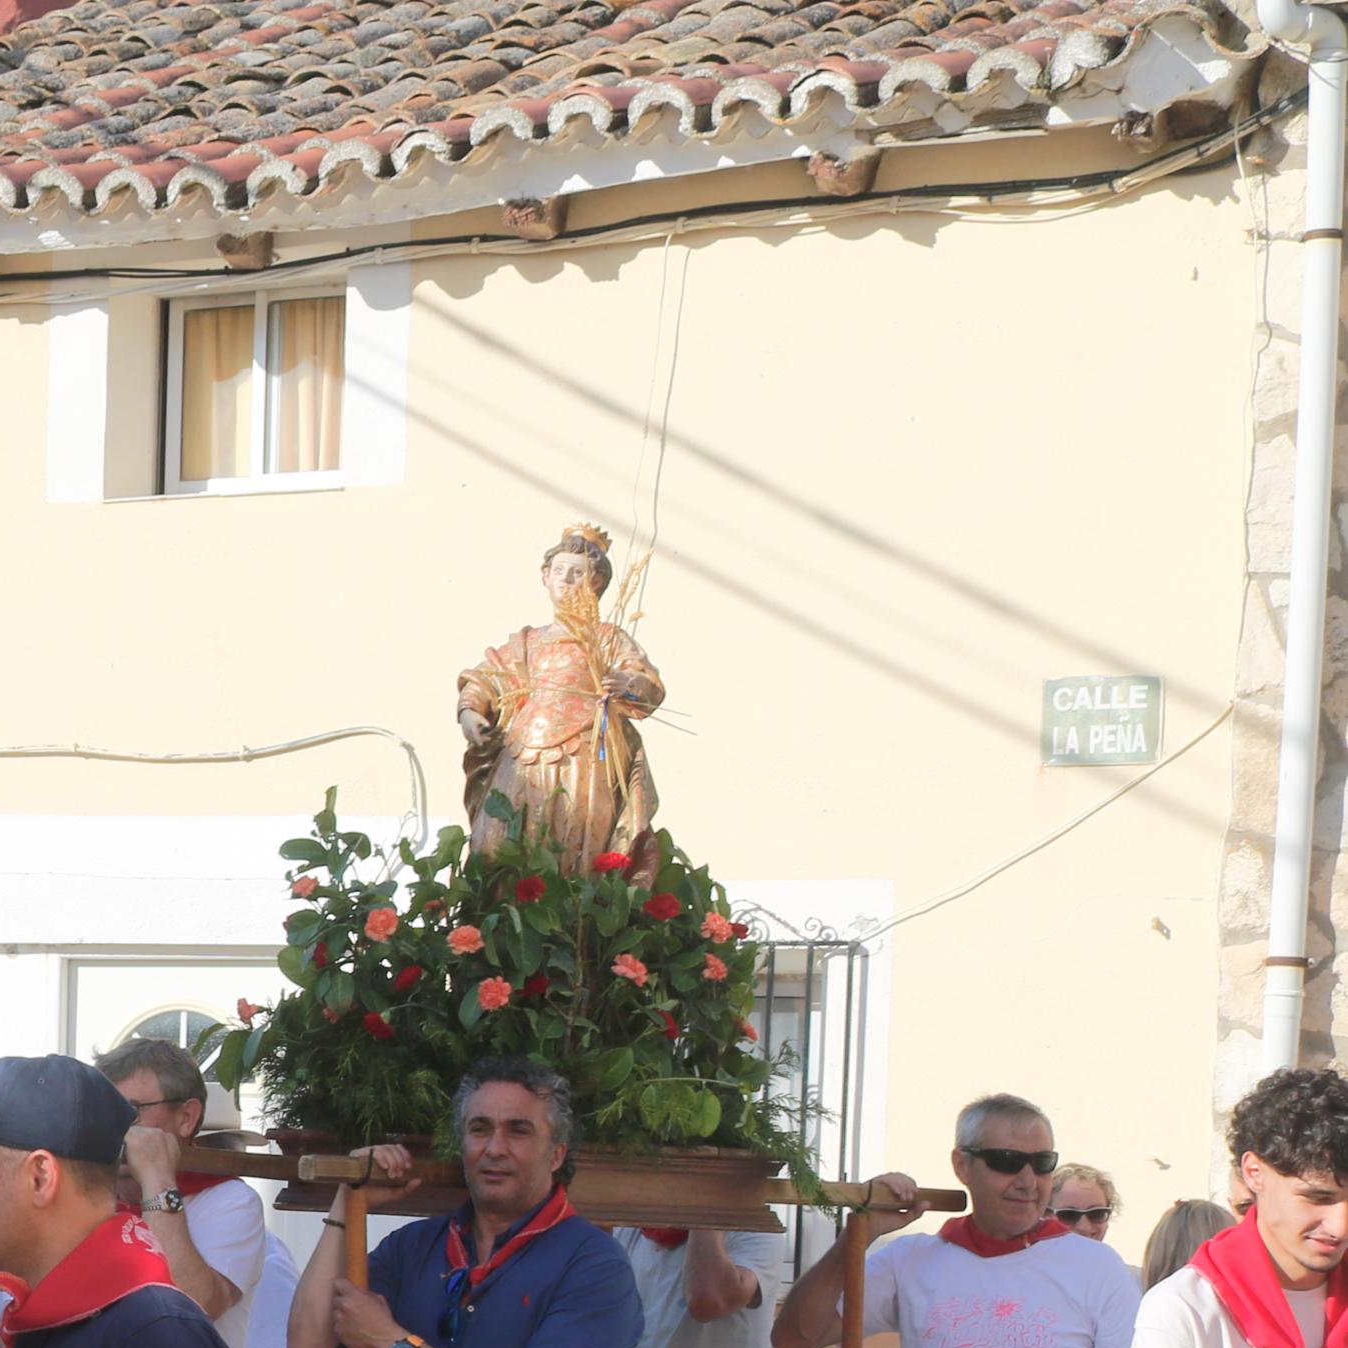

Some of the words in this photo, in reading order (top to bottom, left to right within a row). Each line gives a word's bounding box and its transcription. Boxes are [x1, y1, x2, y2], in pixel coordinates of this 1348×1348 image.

[1052, 685, 1149, 711] CALLE
[1052, 726, 1080, 755] LA
[1089, 715, 1147, 754] PEÑA
